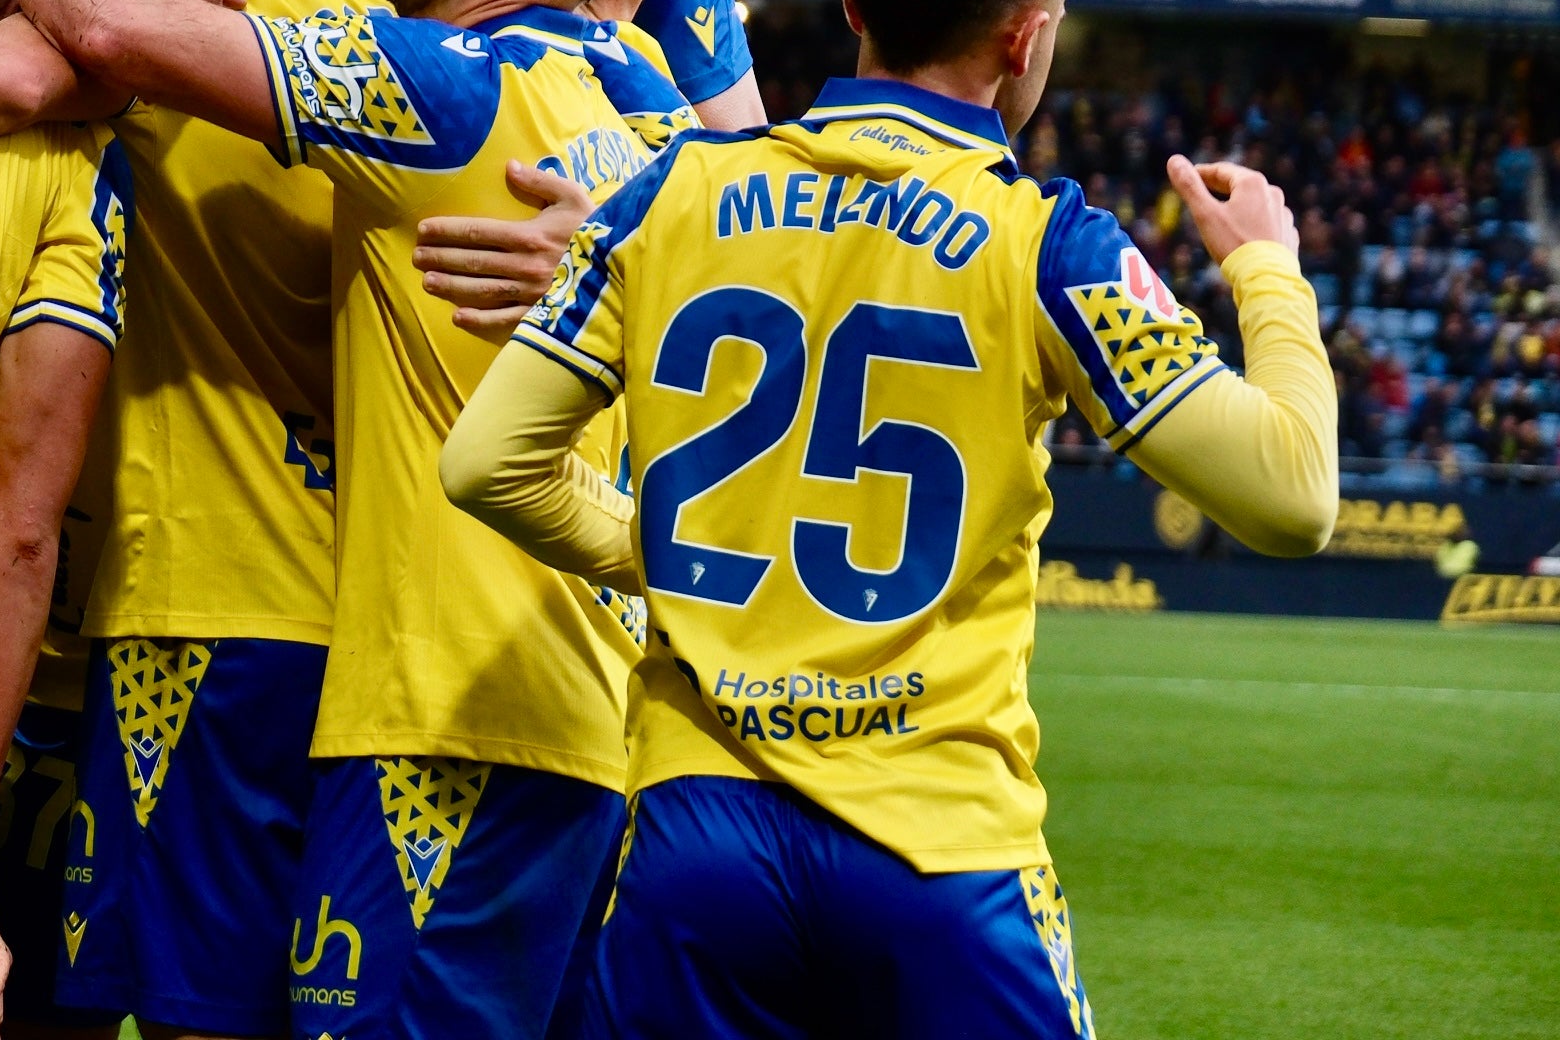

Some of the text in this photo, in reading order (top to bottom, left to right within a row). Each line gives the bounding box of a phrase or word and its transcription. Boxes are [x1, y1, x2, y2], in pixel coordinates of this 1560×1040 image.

[640, 285, 982, 623] 25
[714, 669, 925, 705] Hospitales
[716, 703, 920, 742] PASCUAL
